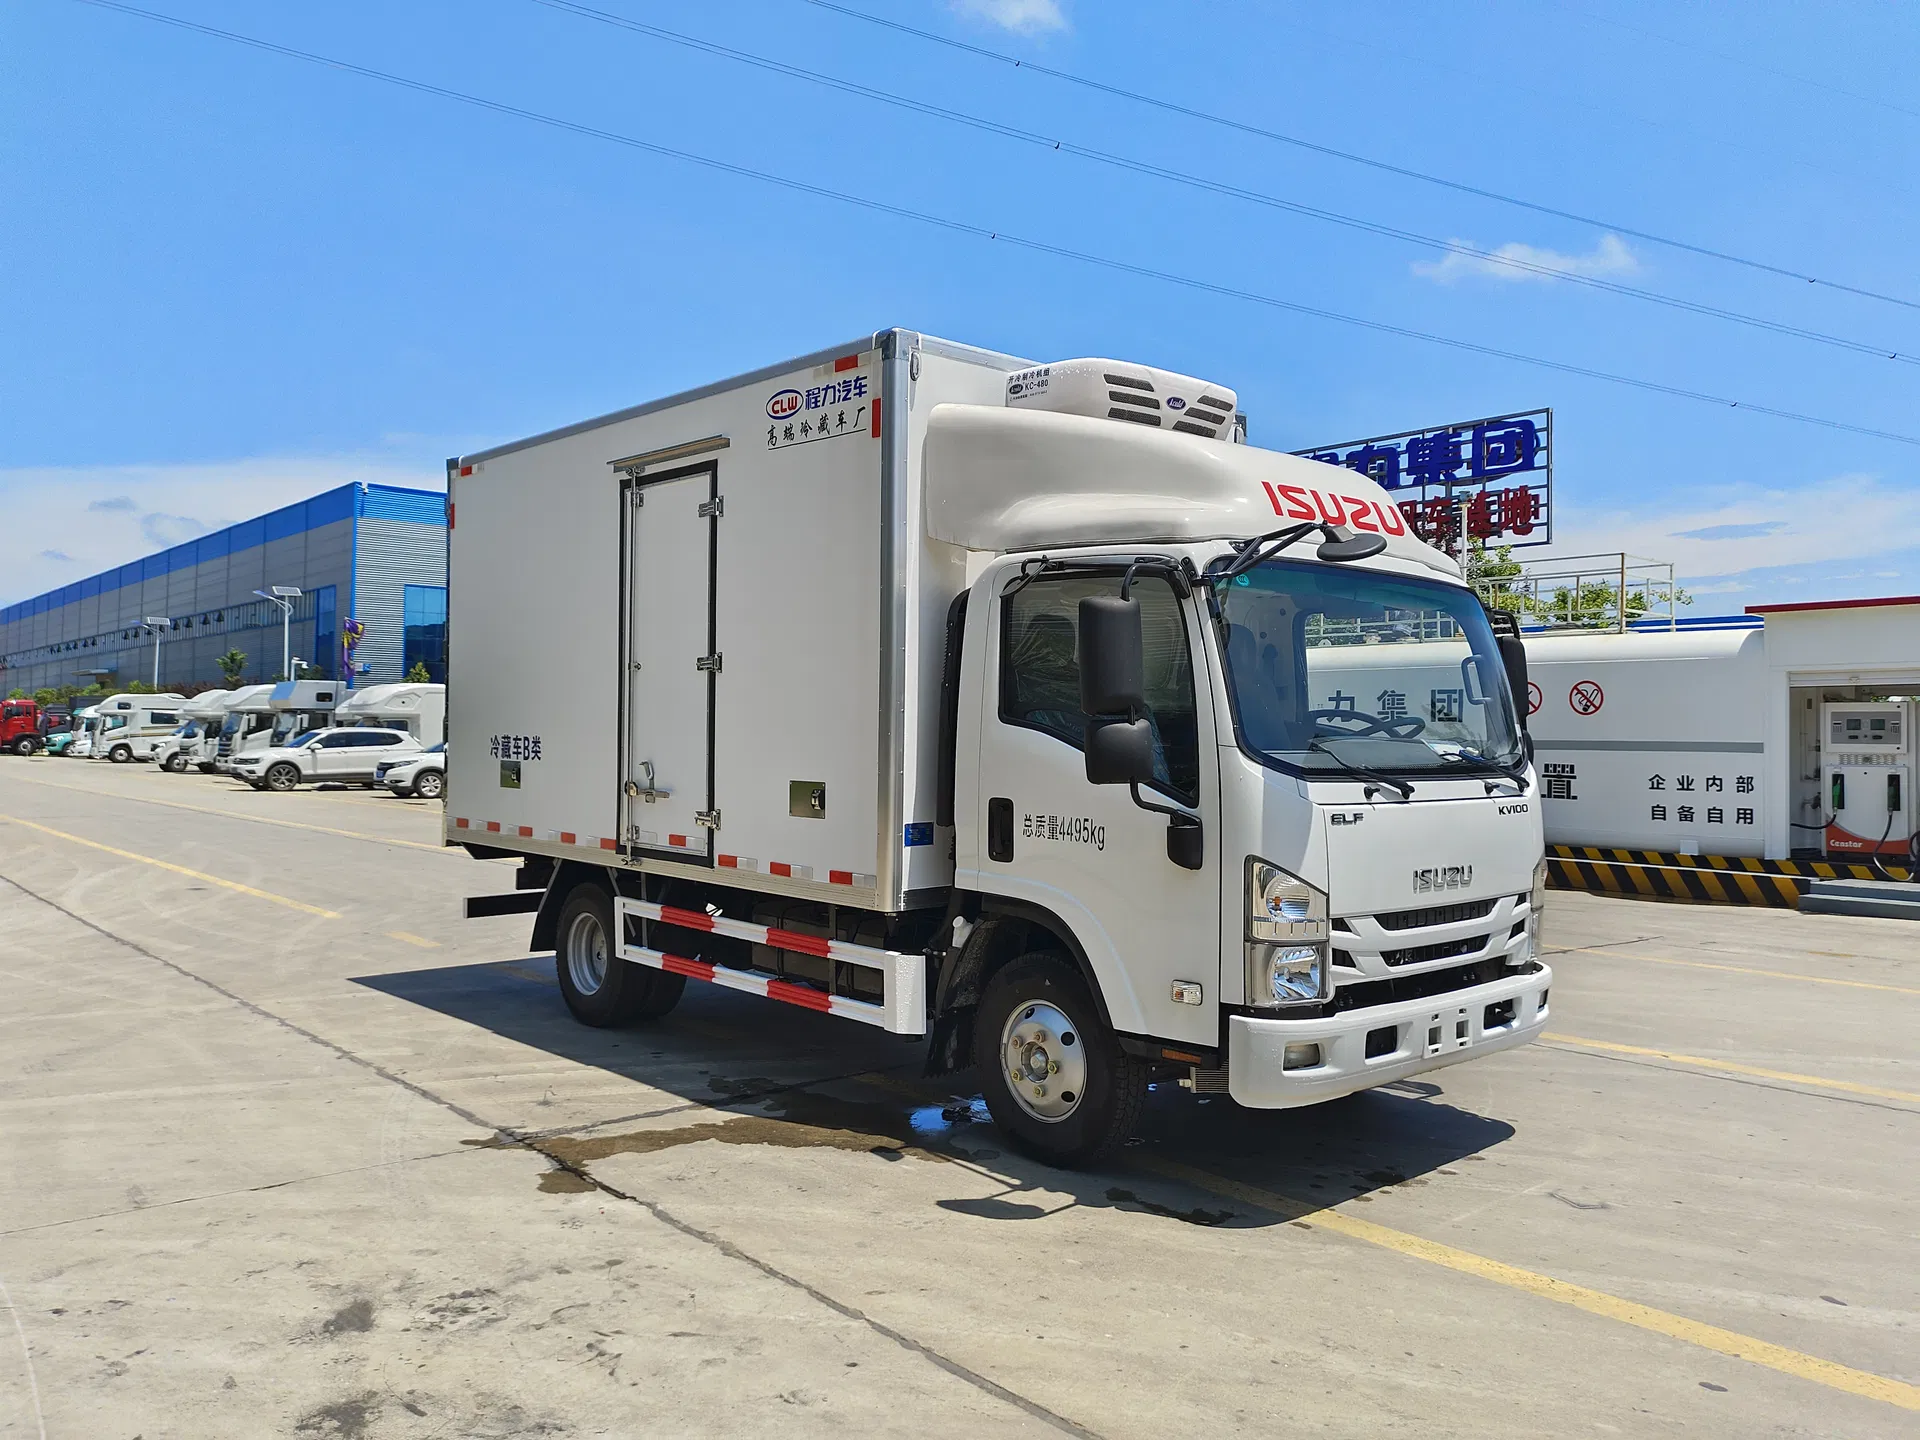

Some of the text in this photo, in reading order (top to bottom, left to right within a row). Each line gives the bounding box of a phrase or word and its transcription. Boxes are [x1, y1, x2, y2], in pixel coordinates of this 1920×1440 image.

[805, 376, 868, 411] 程力汽车
[1024, 379, 1049, 391] KC-480
[771, 395, 798, 415] CLW
[767, 406, 866, 446] 高端冷藏车厂
[1296, 418, 1539, 490] 力集团
[1261, 481, 1405, 537] ISUZU
[490, 734, 542, 761] 冷藏车B类
[1648, 774, 1755, 794] 企业内部
[1330, 812, 1364, 826] ELF
[1498, 803, 1529, 816] KV100
[1650, 804, 1755, 825] 自备自用
[1022, 813, 1106, 852] 总质量4495kg
[1412, 864, 1473, 895] ISUZU
